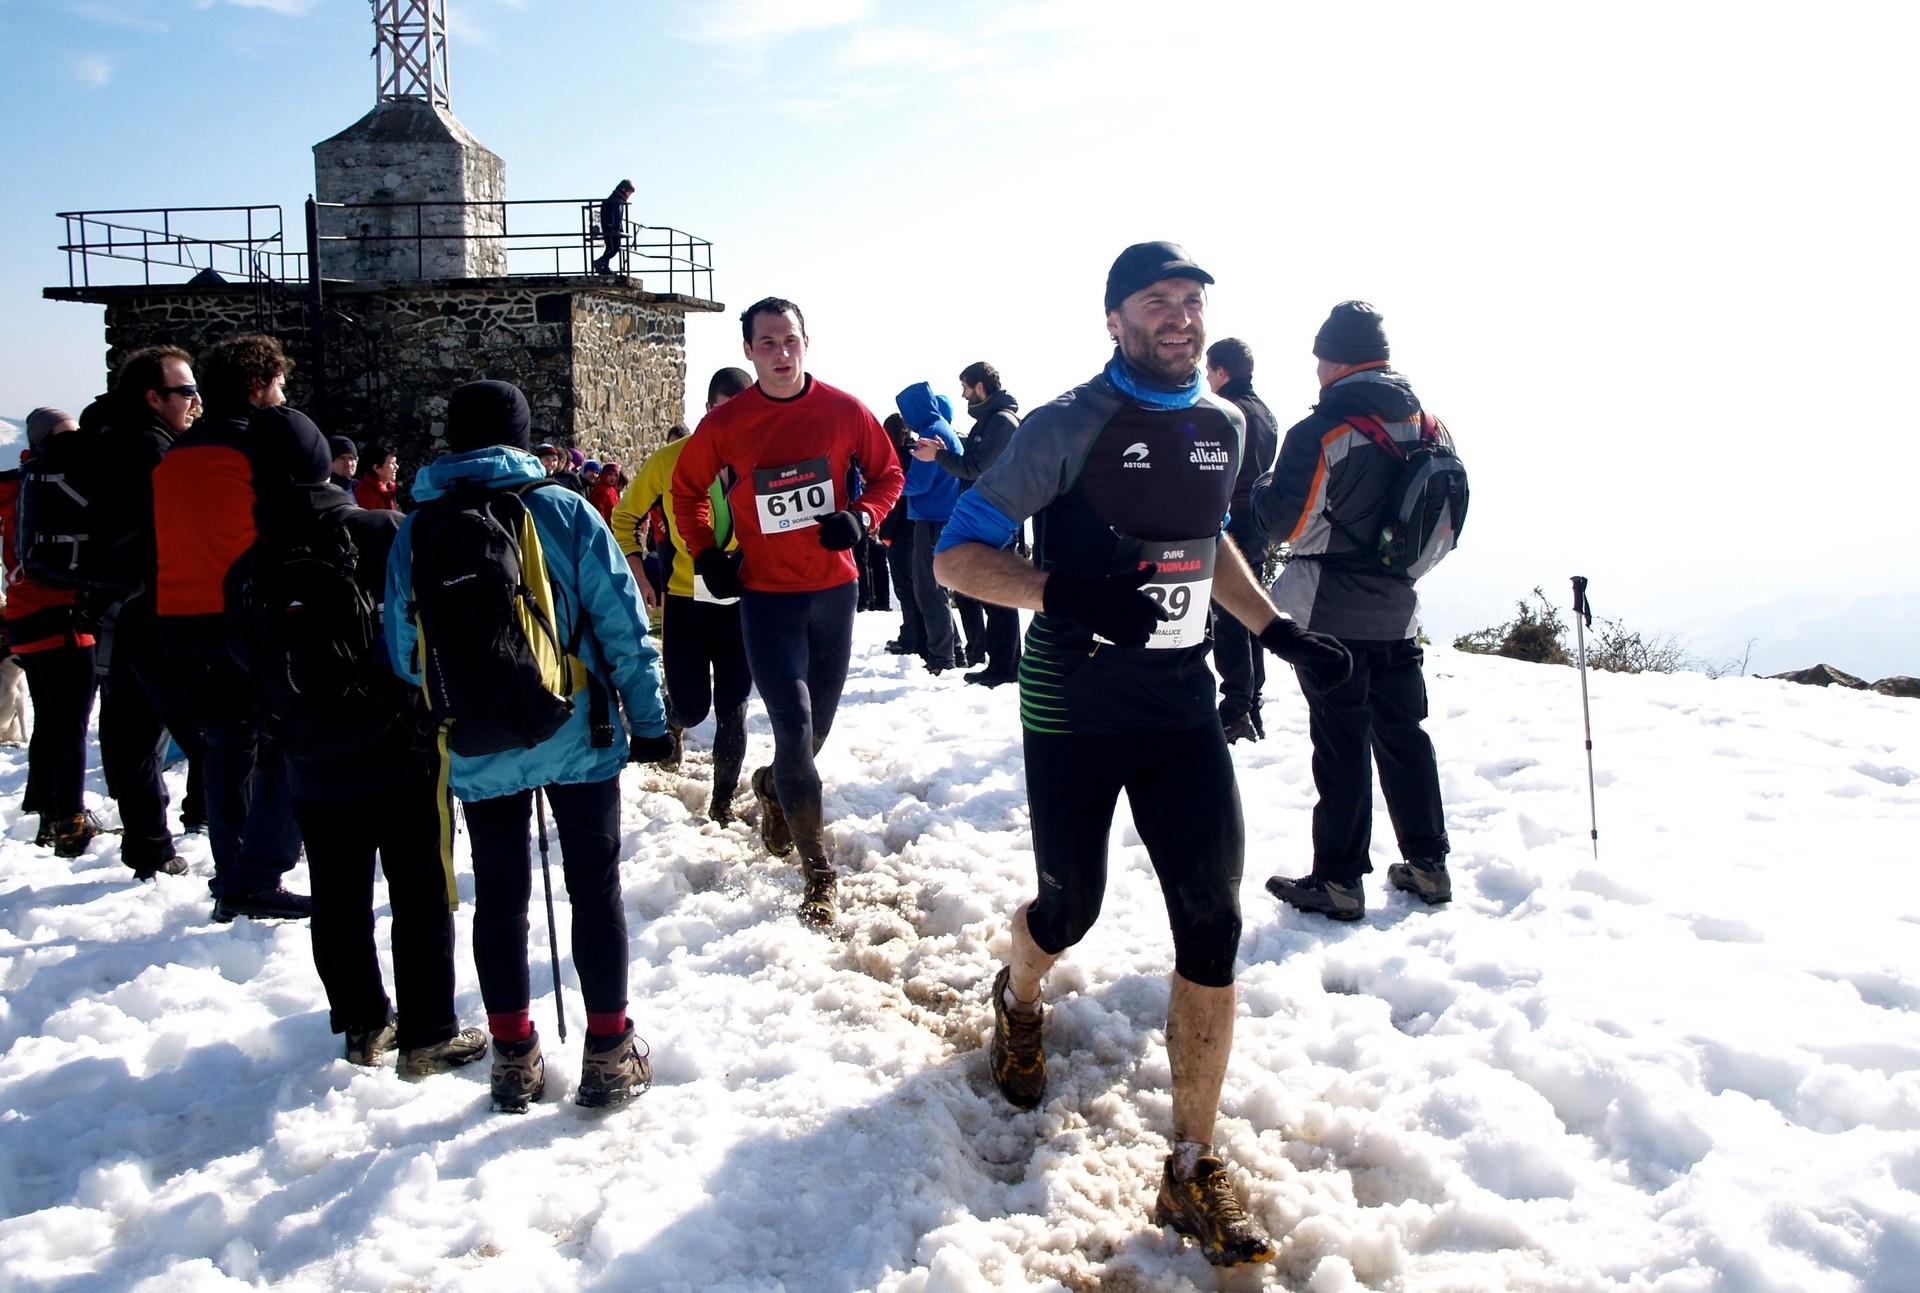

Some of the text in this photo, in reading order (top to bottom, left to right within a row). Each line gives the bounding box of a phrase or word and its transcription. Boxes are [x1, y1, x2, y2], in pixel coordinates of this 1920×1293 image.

[1190, 447, 1228, 463] alkain
[1123, 461, 1151, 469] ASTORE
[768, 471, 816, 488] SERVIMASA
[767, 486, 825, 517] 610
[792, 514, 817, 525] SORALU
[1138, 559, 1203, 573] SRVIMASA
